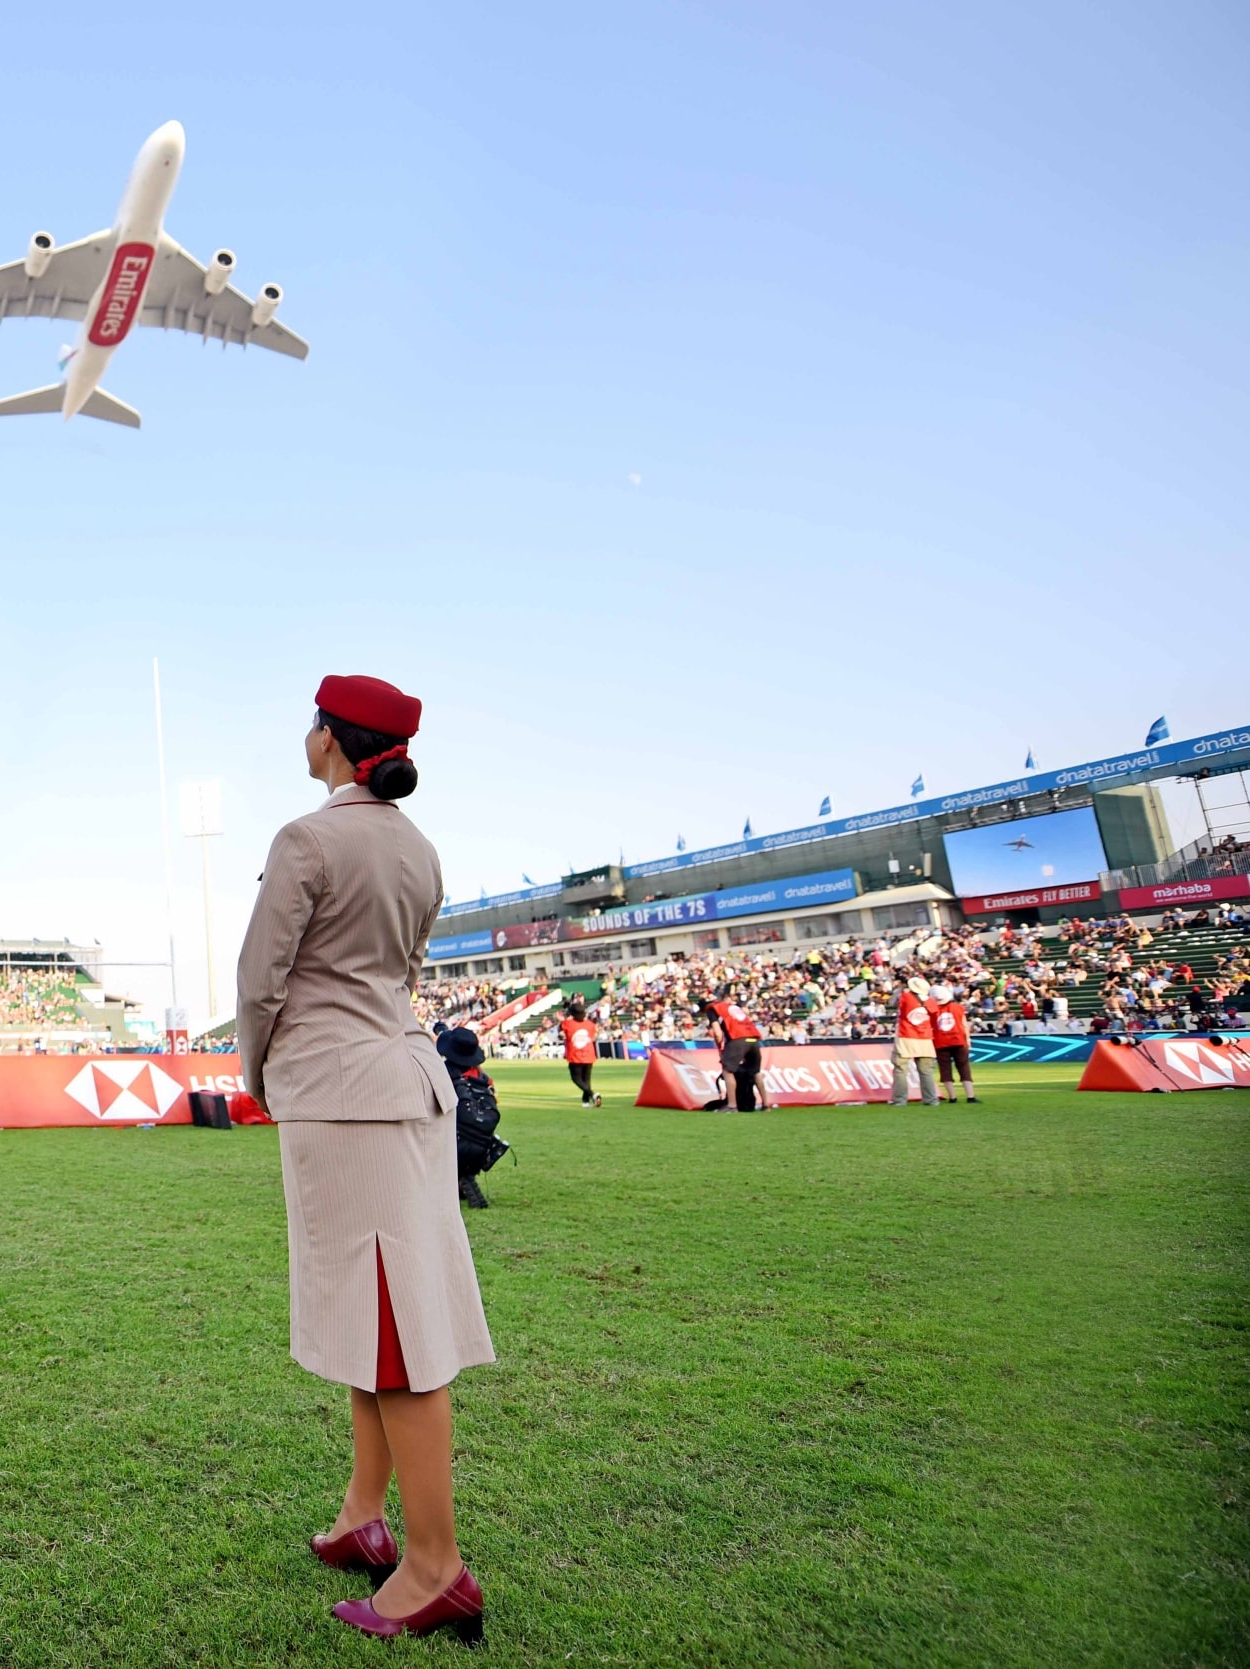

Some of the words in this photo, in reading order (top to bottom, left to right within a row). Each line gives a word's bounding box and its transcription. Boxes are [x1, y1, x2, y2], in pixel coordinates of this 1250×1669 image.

[100, 256, 148, 336] Emirates
[983, 893, 1039, 909] Emirates
[1042, 890, 1057, 902] FLY
[1059, 886, 1091, 900] BETTER
[1153, 883, 1211, 899] marhaba
[582, 913, 631, 933] SOUNDS
[634, 909, 650, 925] OF
[656, 905, 683, 921] THE
[687, 900, 706, 917] 7S
[819, 1059, 861, 1091] FLY
